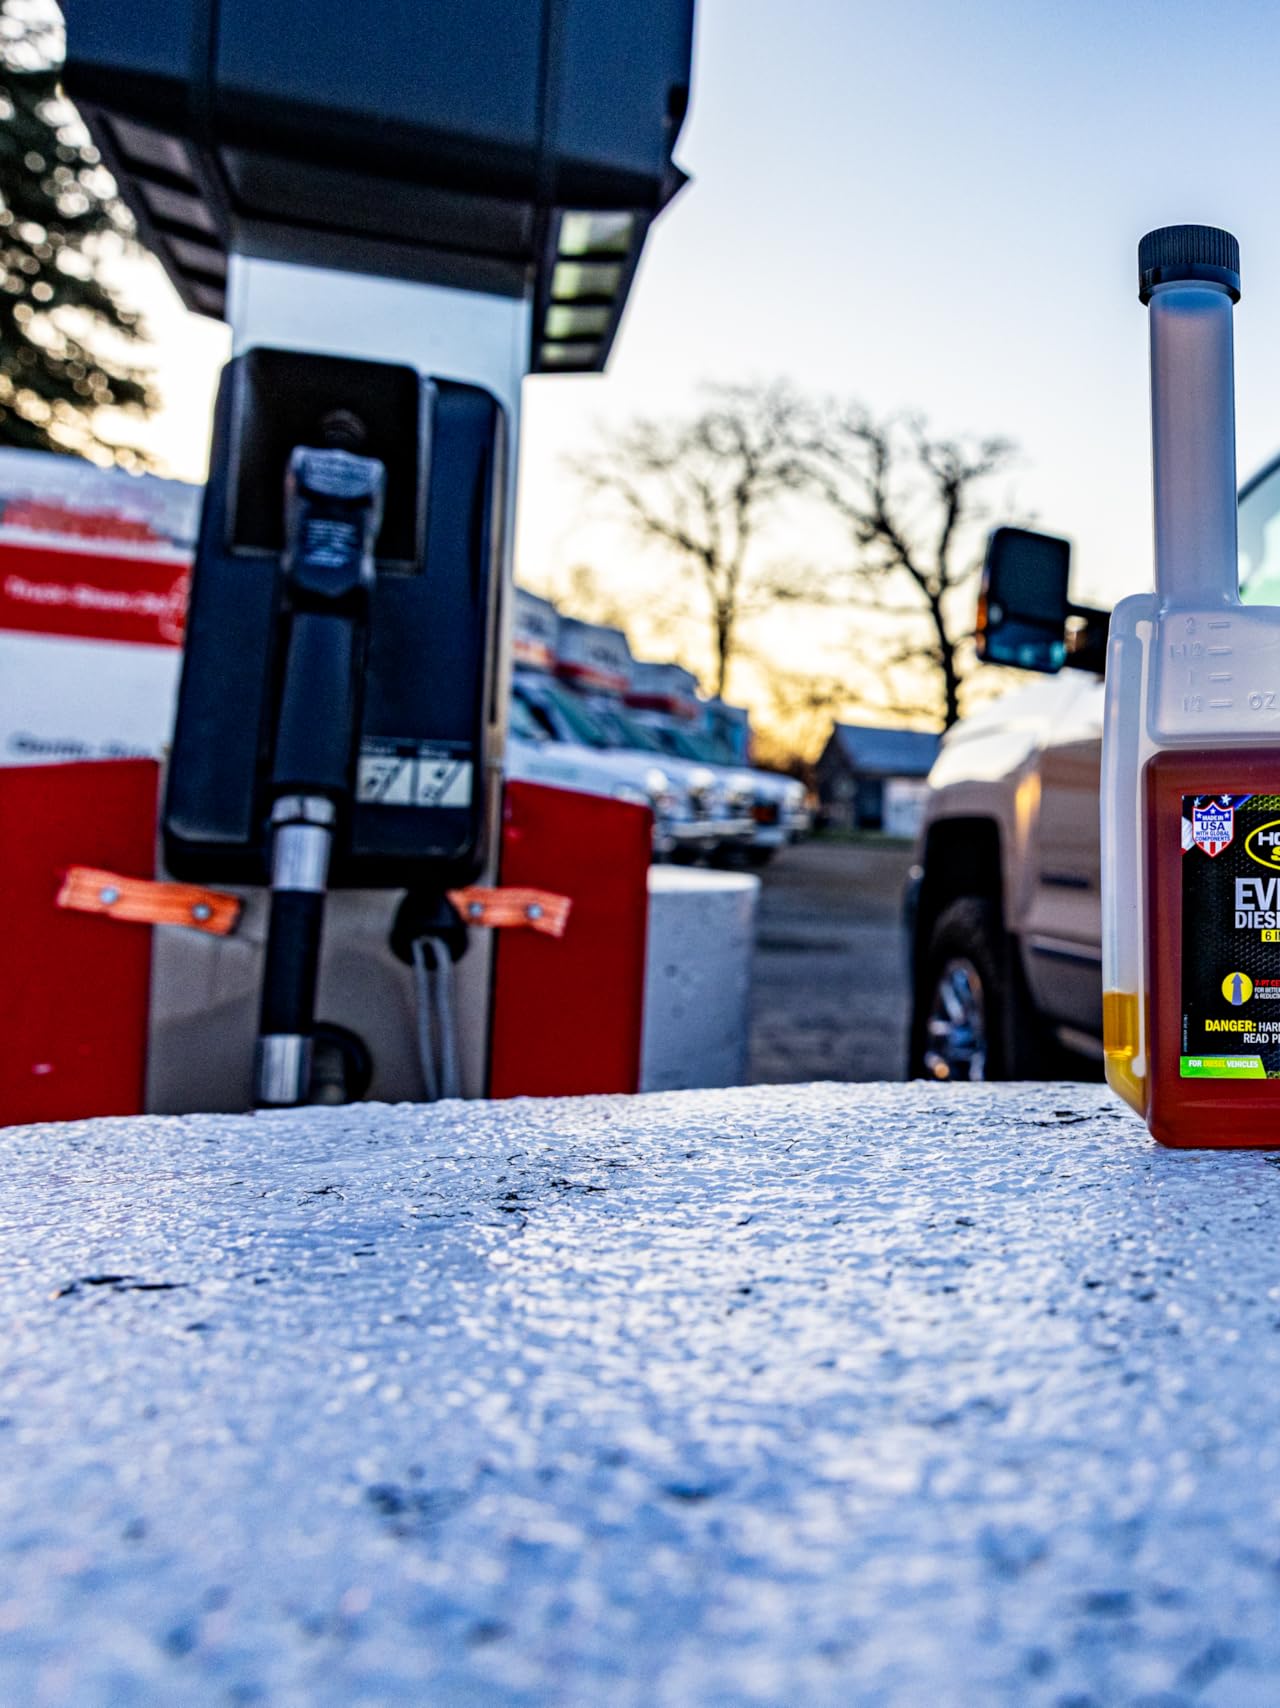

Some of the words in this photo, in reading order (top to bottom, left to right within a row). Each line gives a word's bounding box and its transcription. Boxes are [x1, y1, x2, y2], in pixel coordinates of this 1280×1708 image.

[1248, 691, 1278, 711] OZ
[1201, 821, 1226, 831] USA
[1265, 931, 1271, 941] 6
[1205, 1019, 1257, 1032] DANGER:
[1243, 1033, 1269, 1044] READ
[1188, 1059, 1202, 1067] FOR
[1226, 1060, 1259, 1068] VEHICLES
